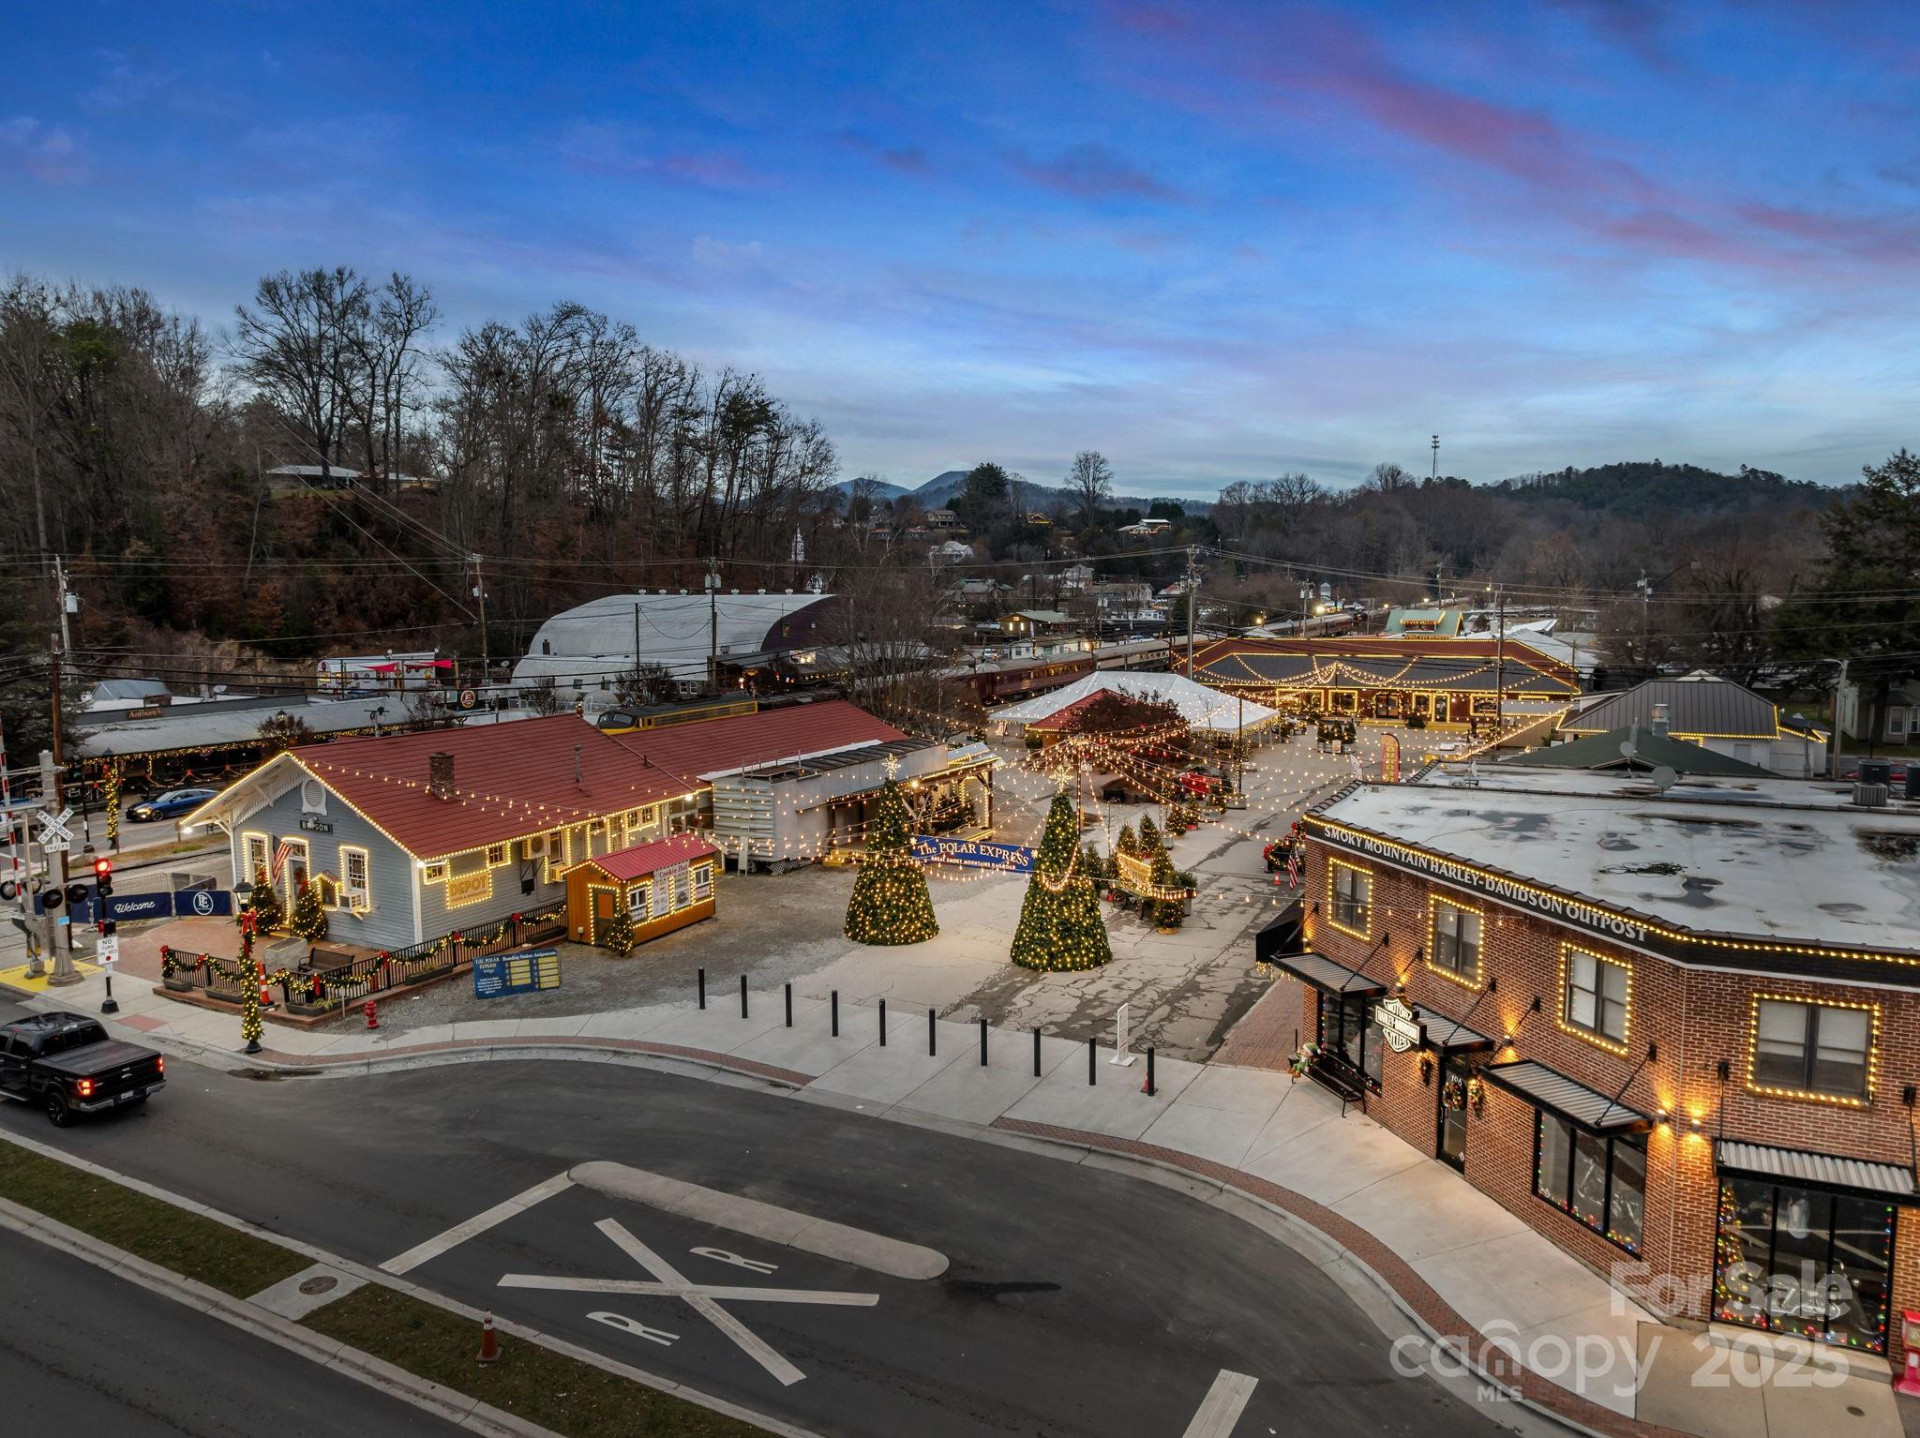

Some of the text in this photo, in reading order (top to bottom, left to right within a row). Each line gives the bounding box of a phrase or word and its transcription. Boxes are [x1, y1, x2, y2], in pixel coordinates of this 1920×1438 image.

[39, 812, 72, 839] RAILROAD
[918, 843, 1030, 867] The POLAR EXPRESS
[450, 876, 487, 896] DEPOT
[1324, 826, 1647, 941] SMOKY MOUNTAIN HARLEY-DAVIDSON OUTPOST
[114, 901, 156, 914] Welcome
[1451, 1074, 1463, 1087] 106
